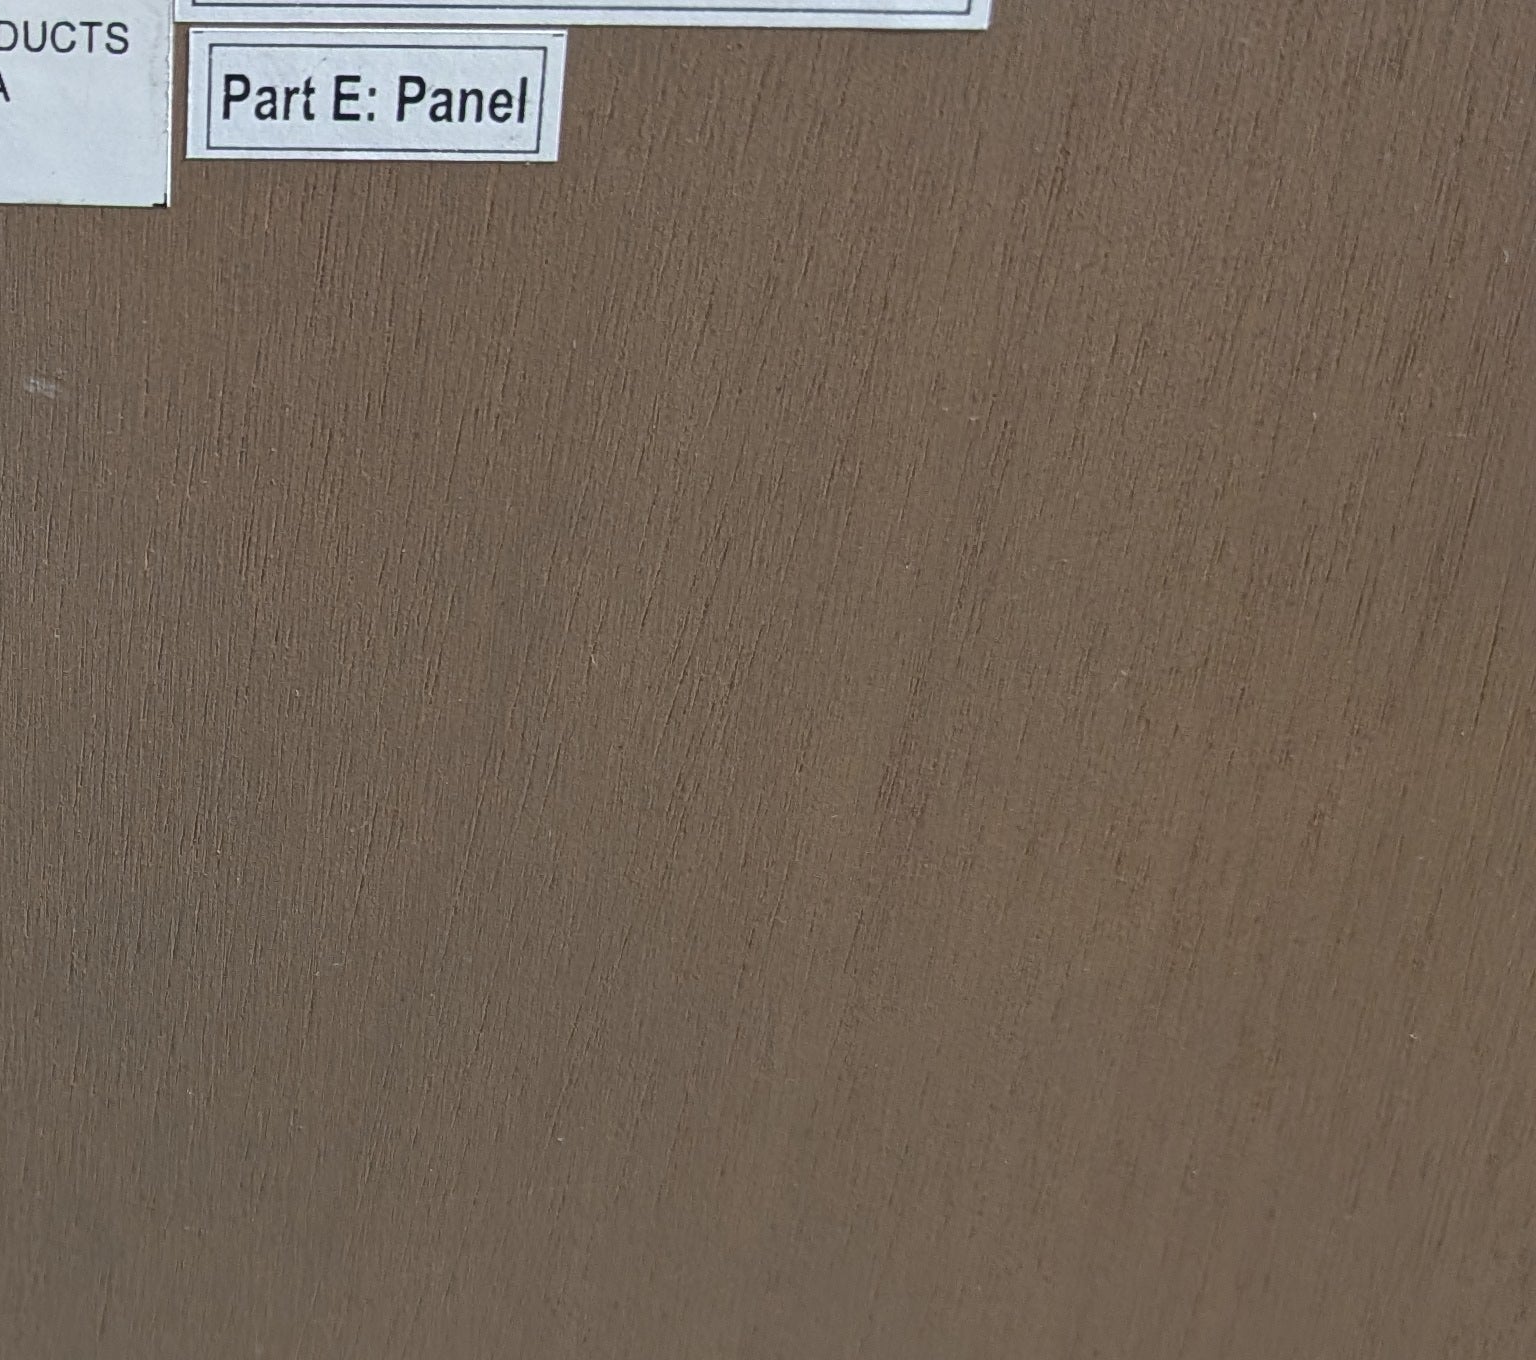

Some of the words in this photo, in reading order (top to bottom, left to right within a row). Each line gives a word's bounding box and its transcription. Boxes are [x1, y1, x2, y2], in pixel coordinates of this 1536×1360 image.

[219, 74, 316, 121] Part
[332, 74, 377, 122] E:
[396, 74, 528, 124] Panel
